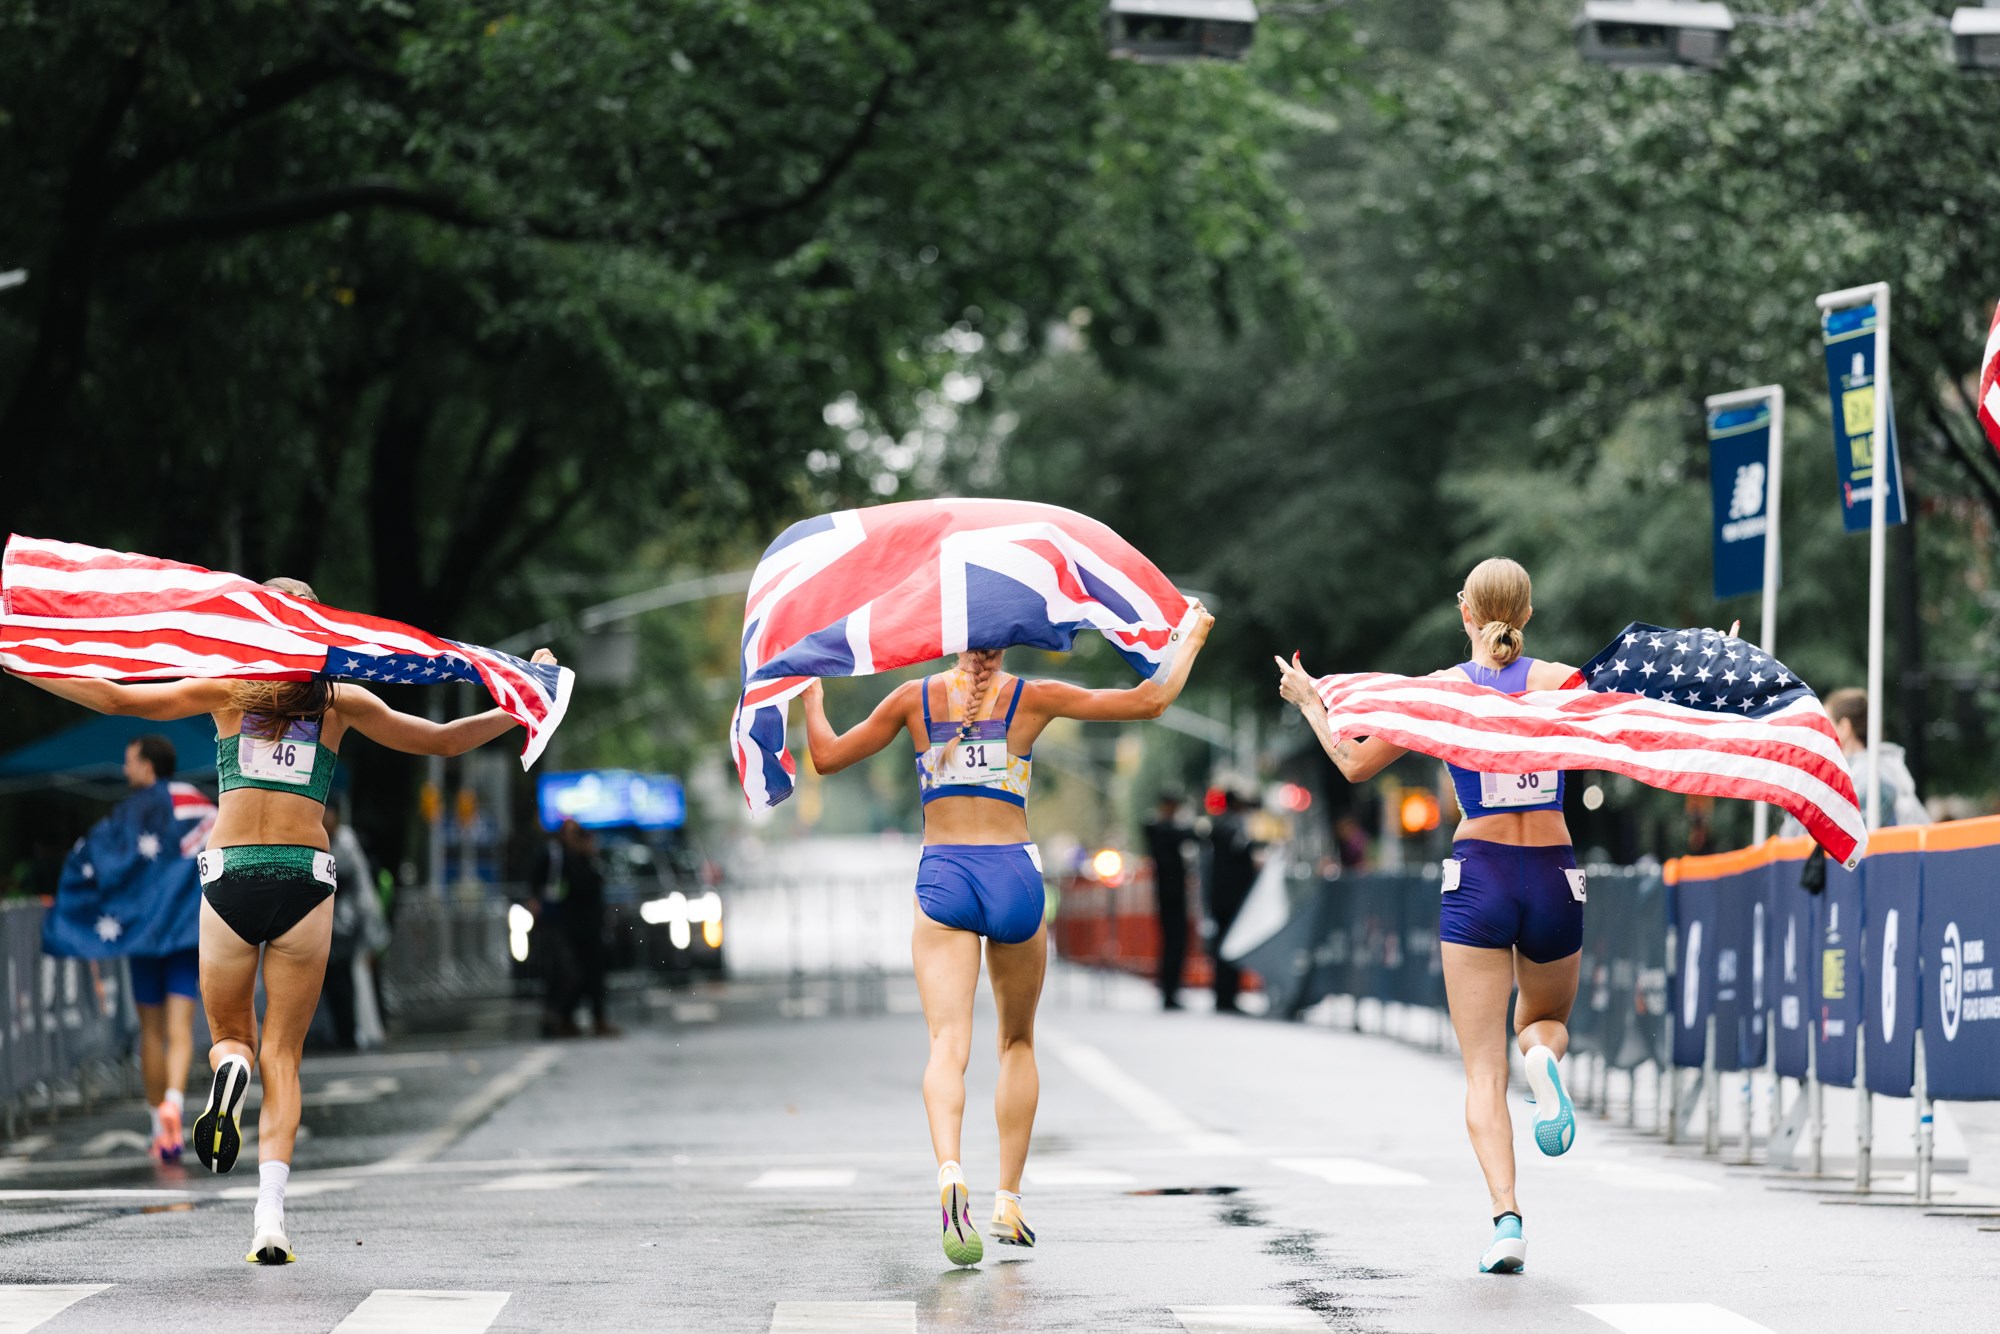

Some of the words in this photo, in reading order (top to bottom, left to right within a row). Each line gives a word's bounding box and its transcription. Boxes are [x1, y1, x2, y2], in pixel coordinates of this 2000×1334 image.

[272, 743, 297, 767] 46
[965, 745, 988, 768] 31
[1516, 772, 1540, 789] 36
[199, 857, 209, 876] 6
